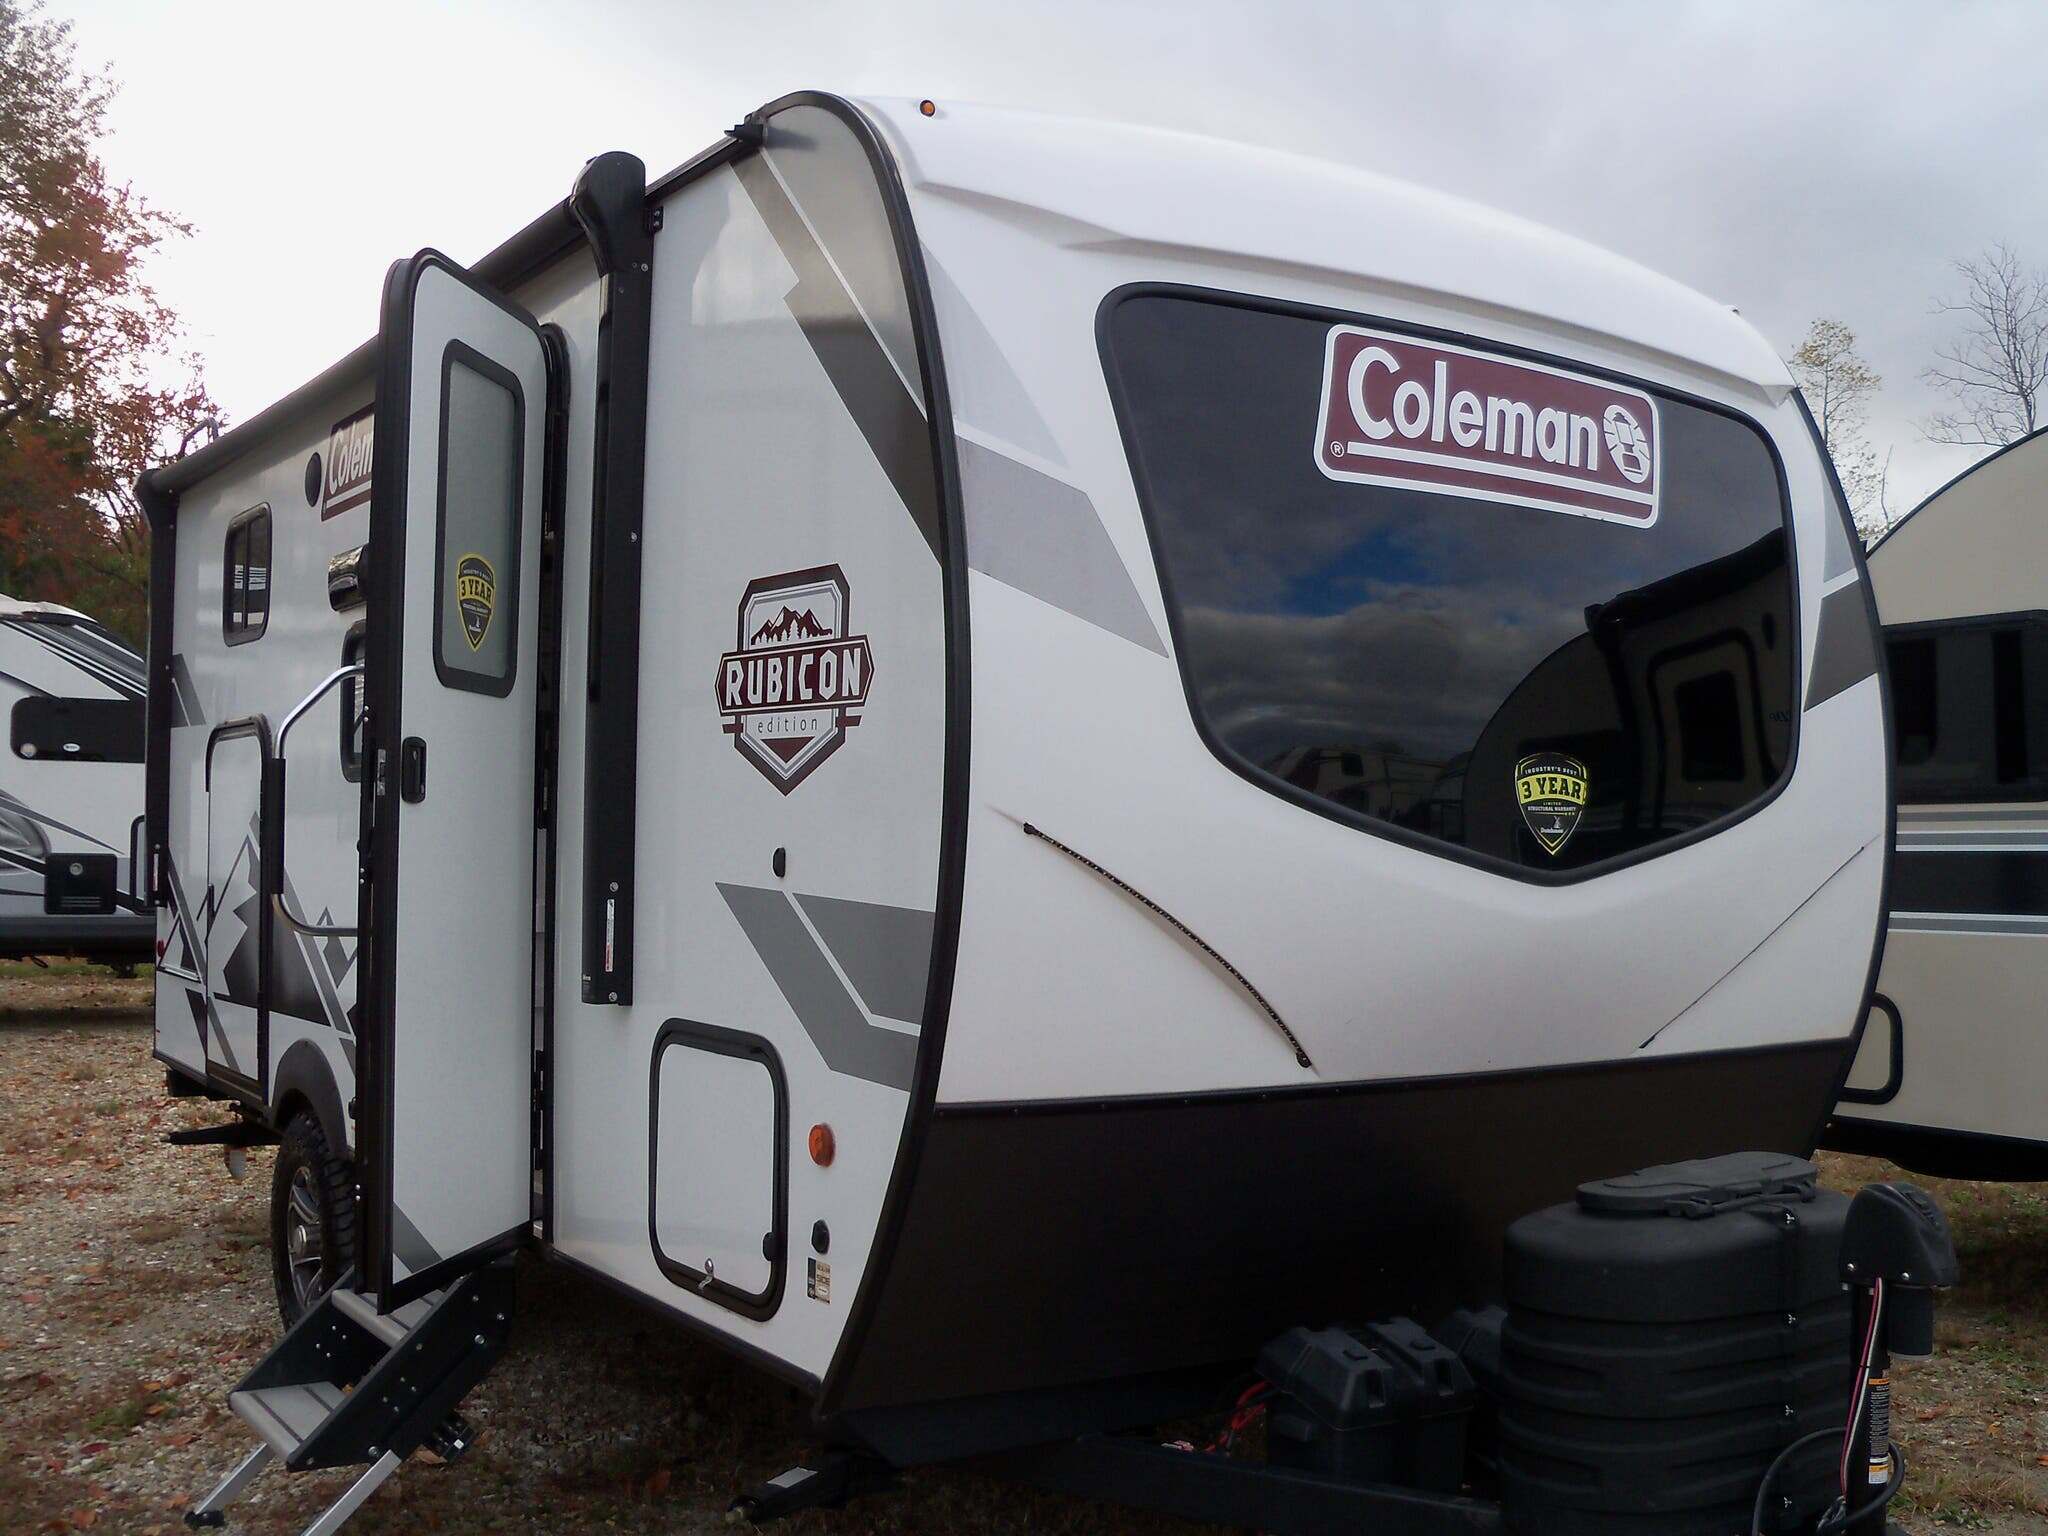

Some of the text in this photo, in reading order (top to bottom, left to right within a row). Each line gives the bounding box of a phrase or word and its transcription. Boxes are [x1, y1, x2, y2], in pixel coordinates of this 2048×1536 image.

[1347, 346, 1599, 471] Coleman
[329, 421, 373, 495] Colem
[460, 578, 492, 605] 3 YEAR
[725, 648, 861, 707] RUBICON
[757, 717, 818, 734] edition
[1521, 777, 1581, 800] 3 YEAR
